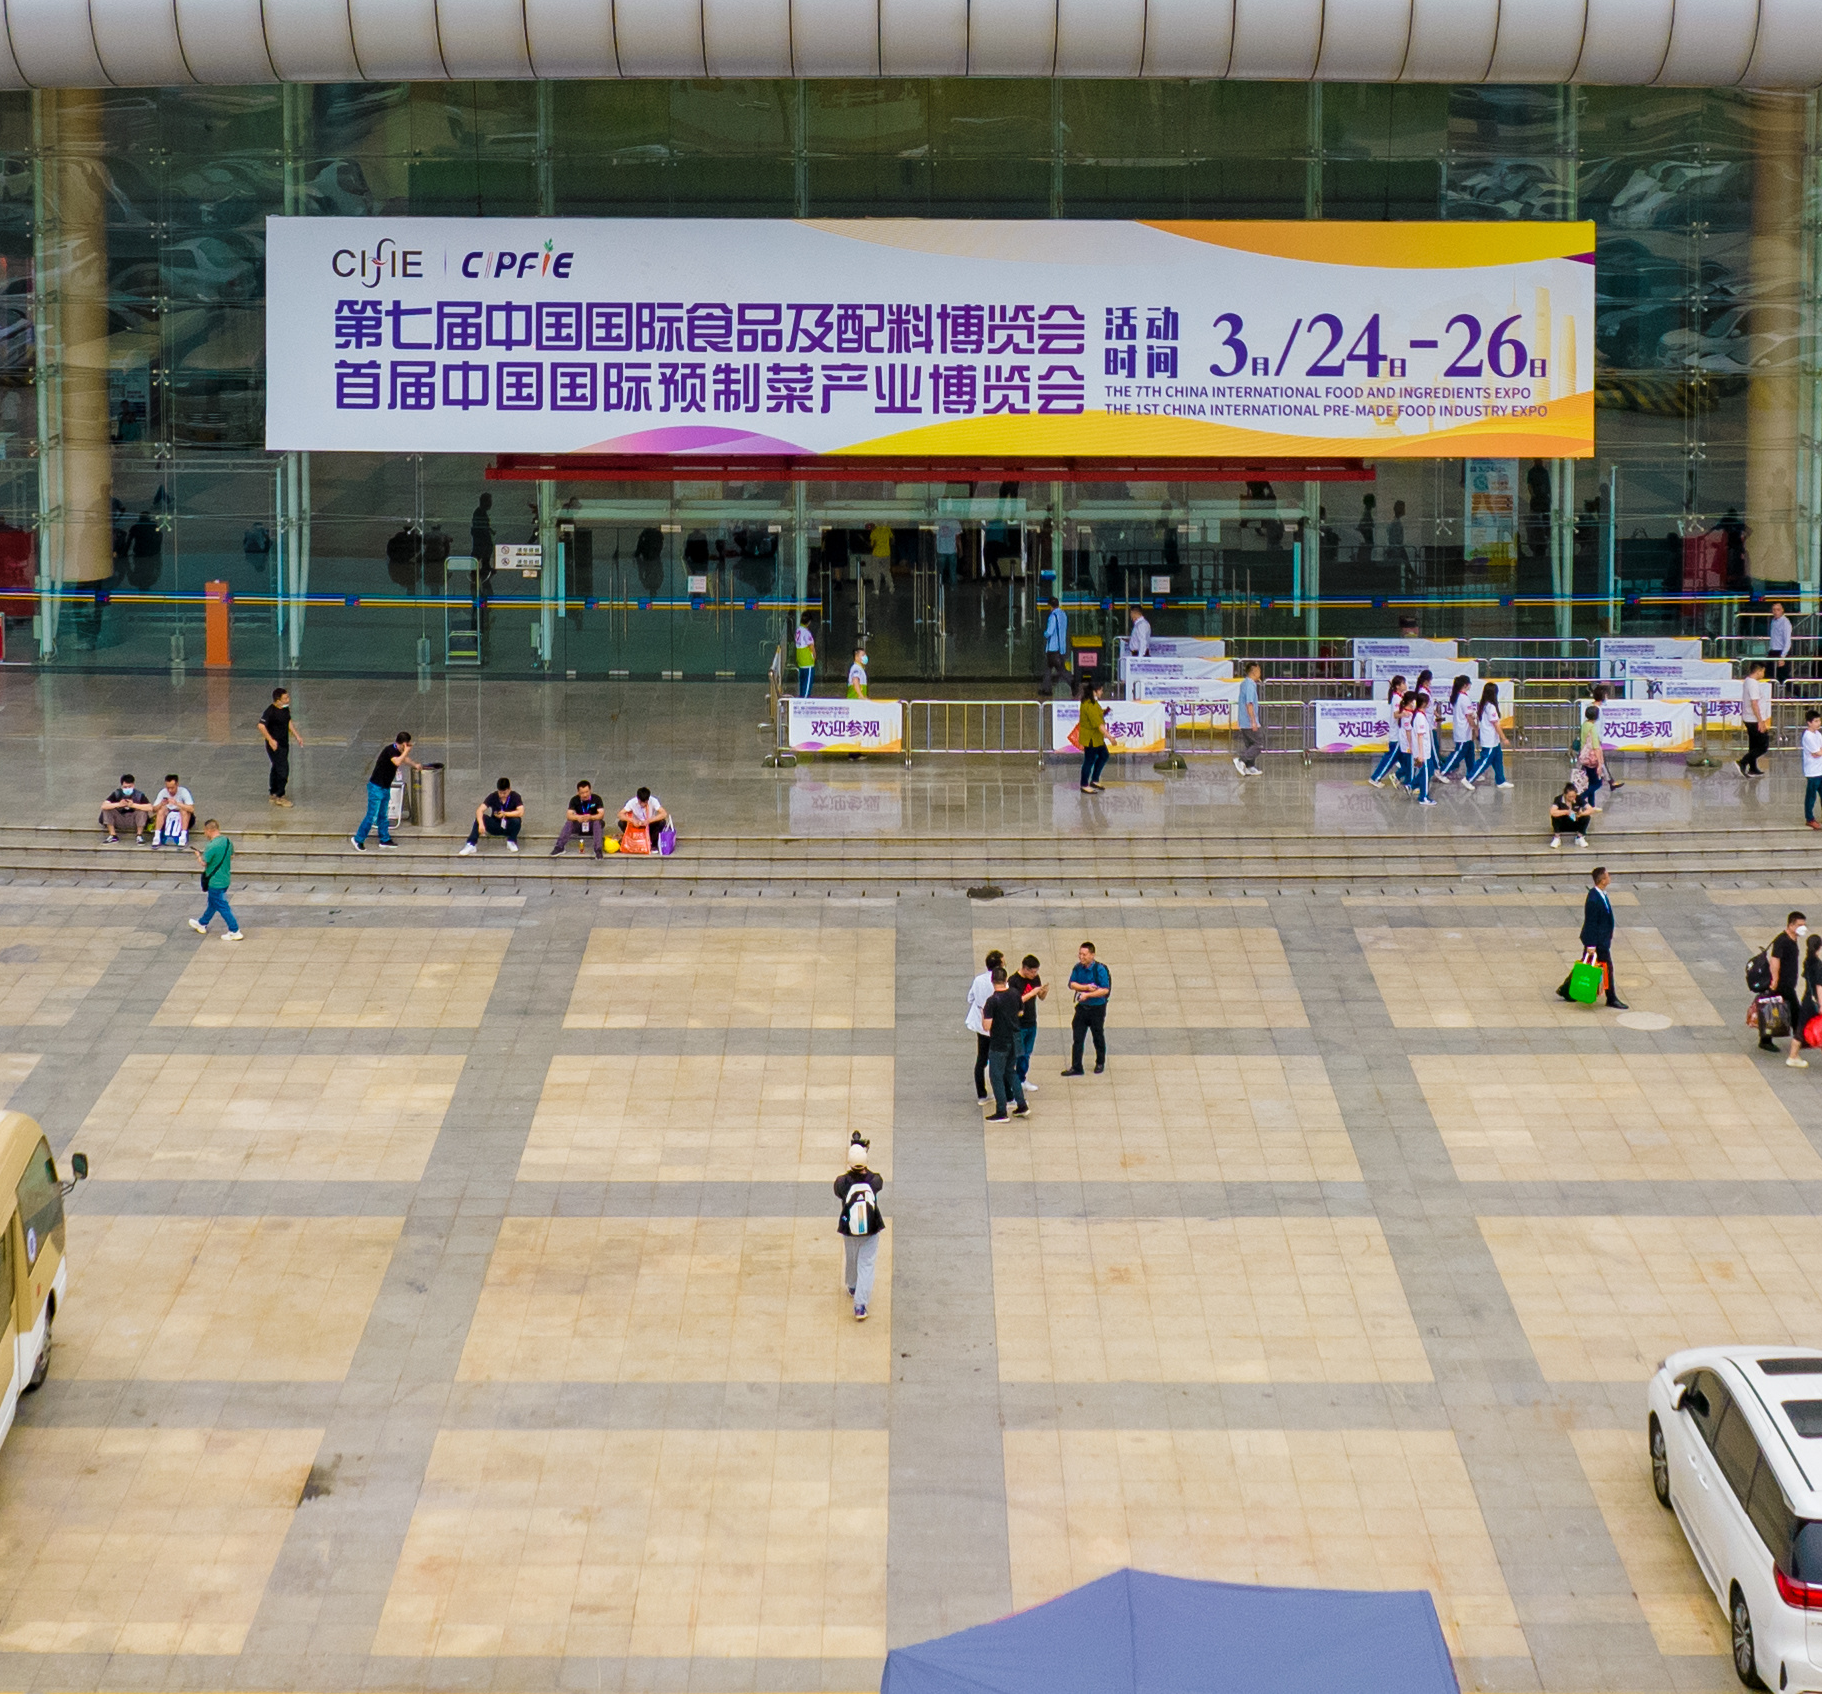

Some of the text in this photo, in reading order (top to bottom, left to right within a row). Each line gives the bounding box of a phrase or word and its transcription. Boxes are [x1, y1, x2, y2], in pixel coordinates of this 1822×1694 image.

[334, 299, 1086, 355] 第七届中国国际食品及配料博览会
[1104, 306, 1179, 341] 活动
[1104, 344, 1178, 379] 时间
[334, 359, 1086, 415] 首届中国国际预制菜产业博览会
[1104, 386, 1531, 399] THE 7TH CHINA INTERNATIONAL FOOD AND INGREDIENTS EXPO
[1104, 404, 1548, 417] THE 1ST CHINA INTERNATIONAL PRE-MADE FOOD INDUSTRY EXPO
[811, 719, 880, 738] 欢迎参观
[1104, 721, 1144, 738] 参观
[1338, 720, 1390, 738] 欢迎参
[1603, 720, 1673, 738] 欢迎参观
